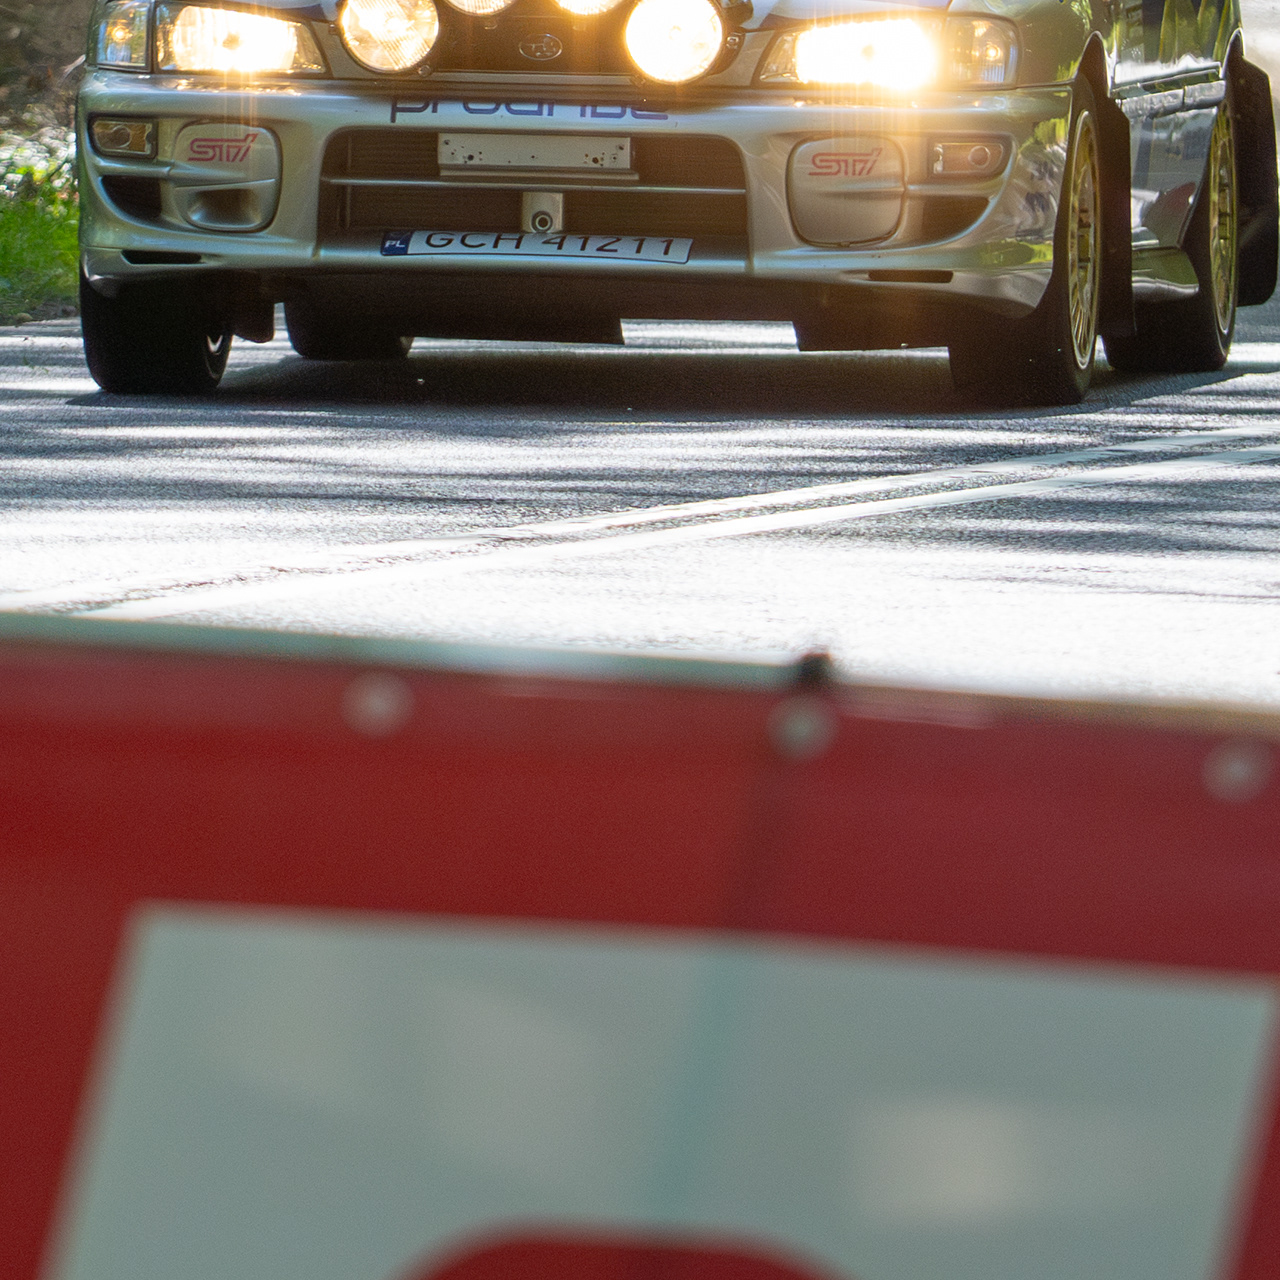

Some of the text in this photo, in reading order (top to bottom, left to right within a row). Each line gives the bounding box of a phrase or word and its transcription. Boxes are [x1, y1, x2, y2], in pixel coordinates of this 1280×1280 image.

[384, 239, 406, 249] PL
[424, 231, 675, 256] GCH 41211
